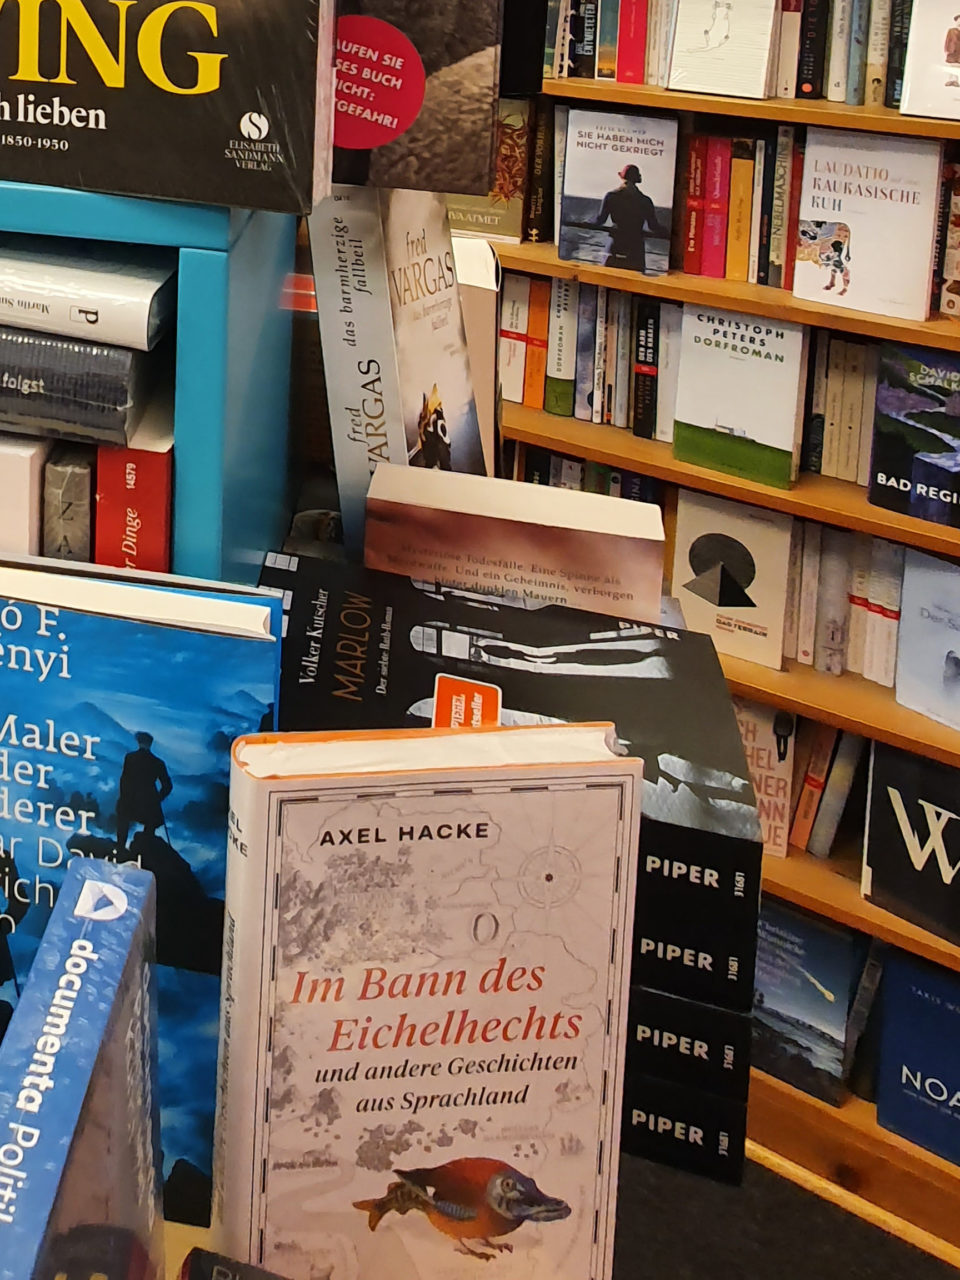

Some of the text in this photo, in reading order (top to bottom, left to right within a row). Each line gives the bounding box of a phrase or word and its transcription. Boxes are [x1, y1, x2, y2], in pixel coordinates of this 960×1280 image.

[382, 54, 405, 70] SIE
[361, 67, 403, 91] BUCH
[16, 95, 108, 131] lieben
[1, 133, 70, 152] 1850-1950
[576, 140, 665, 157] NICHT GEKRIEGT
[577, 130, 665, 148] SIE HABEN MICH
[813, 159, 890, 182] LAUDATIO
[772, 140, 790, 237] NEBELMASCHINE
[811, 195, 843, 212] KUH
[813, 177, 921, 206] KAUKASISCHE
[389, 250, 456, 308] VARGAS
[696, 313, 785, 340] CHRISTOPH
[712, 327, 767, 347] PETERS
[693, 335, 785, 364] DORFROMAN
[920, 364, 960, 381] DAVID
[125, 462, 137, 490] 14579
[876, 472, 912, 492] BAD
[120, 506, 142, 556] Dinge
[37, 604, 66, 640] F.
[299, 588, 330, 684] Volker Kutscher
[331, 590, 374, 703] MARLOW
[319, 822, 491, 848] AXEL HACKE
[646, 856, 720, 889] PIPER
[639, 937, 714, 972] PIPER
[290, 956, 546, 1005] Im Bann des
[16, 938, 100, 1112] documenta
[326, 1005, 584, 1054] Eichelhechts
[636, 1024, 710, 1061] PIPER
[314, 1050, 579, 1084] und andere Geschichten
[355, 1083, 531, 1116] aus Sprachland
[631, 1108, 704, 1146] PIPER
